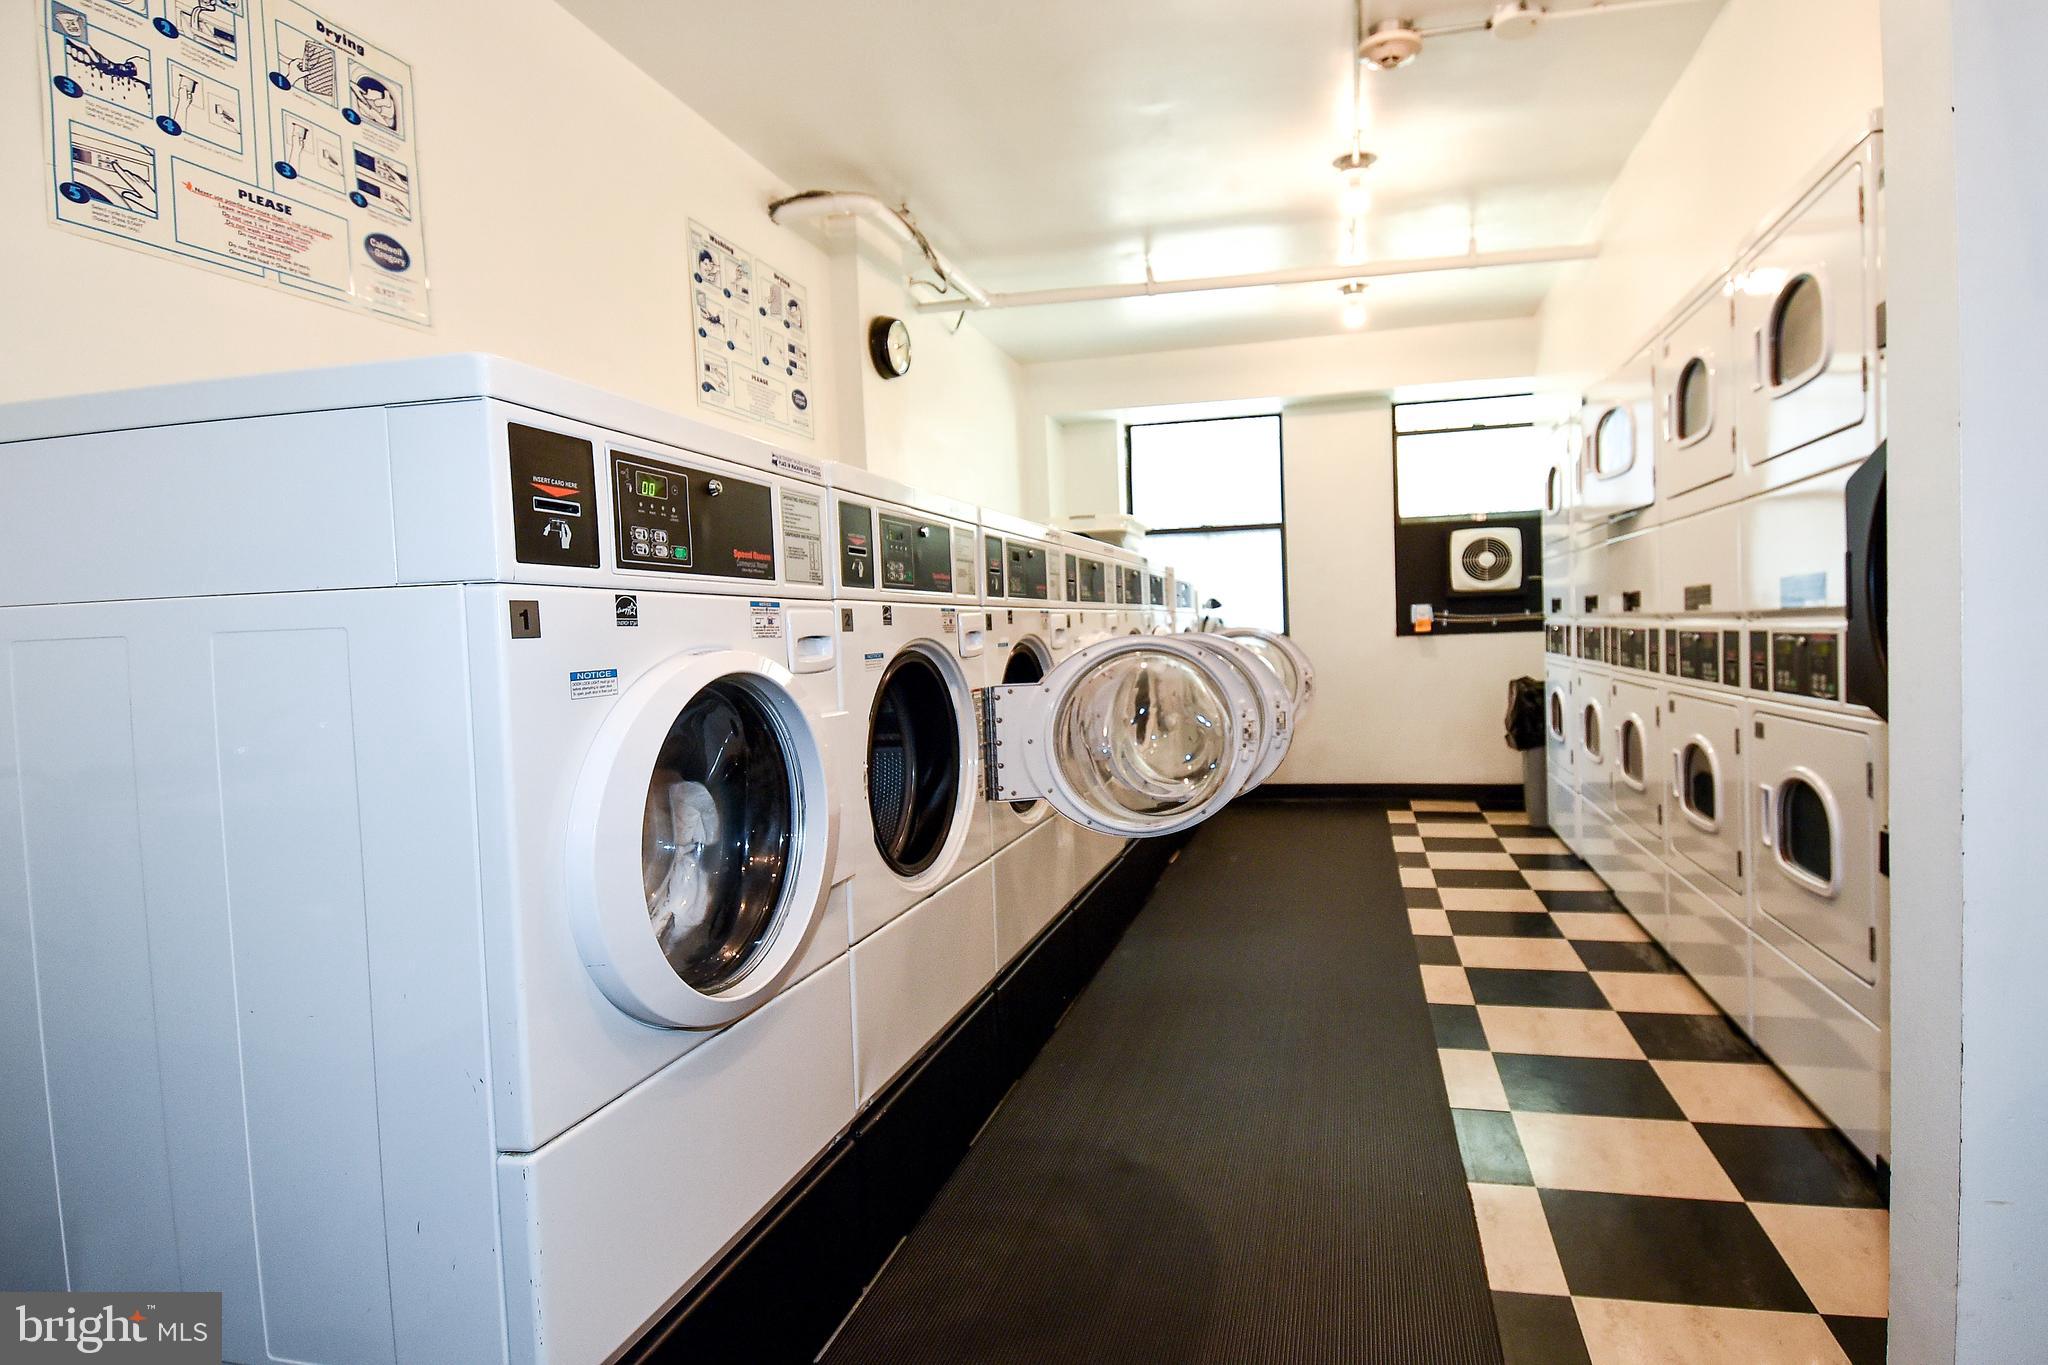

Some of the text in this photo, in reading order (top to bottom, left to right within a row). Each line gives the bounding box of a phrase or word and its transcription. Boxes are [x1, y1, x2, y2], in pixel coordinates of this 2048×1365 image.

[316, 20, 364, 56] Drying
[63, 79, 75, 94] 3
[281, 164, 292, 176] 3
[69, 186, 82, 200] 5
[238, 188, 291, 215] PLEASE
[369, 237, 402, 256] Caldwell
[374, 248, 405, 267] Gregory
[551, 478, 564, 487] CARD
[733, 548, 752, 560] Speed
[520, 609, 529, 630] 1
[844, 613, 850, 627] 2
[577, 671, 611, 679] NOTICE
